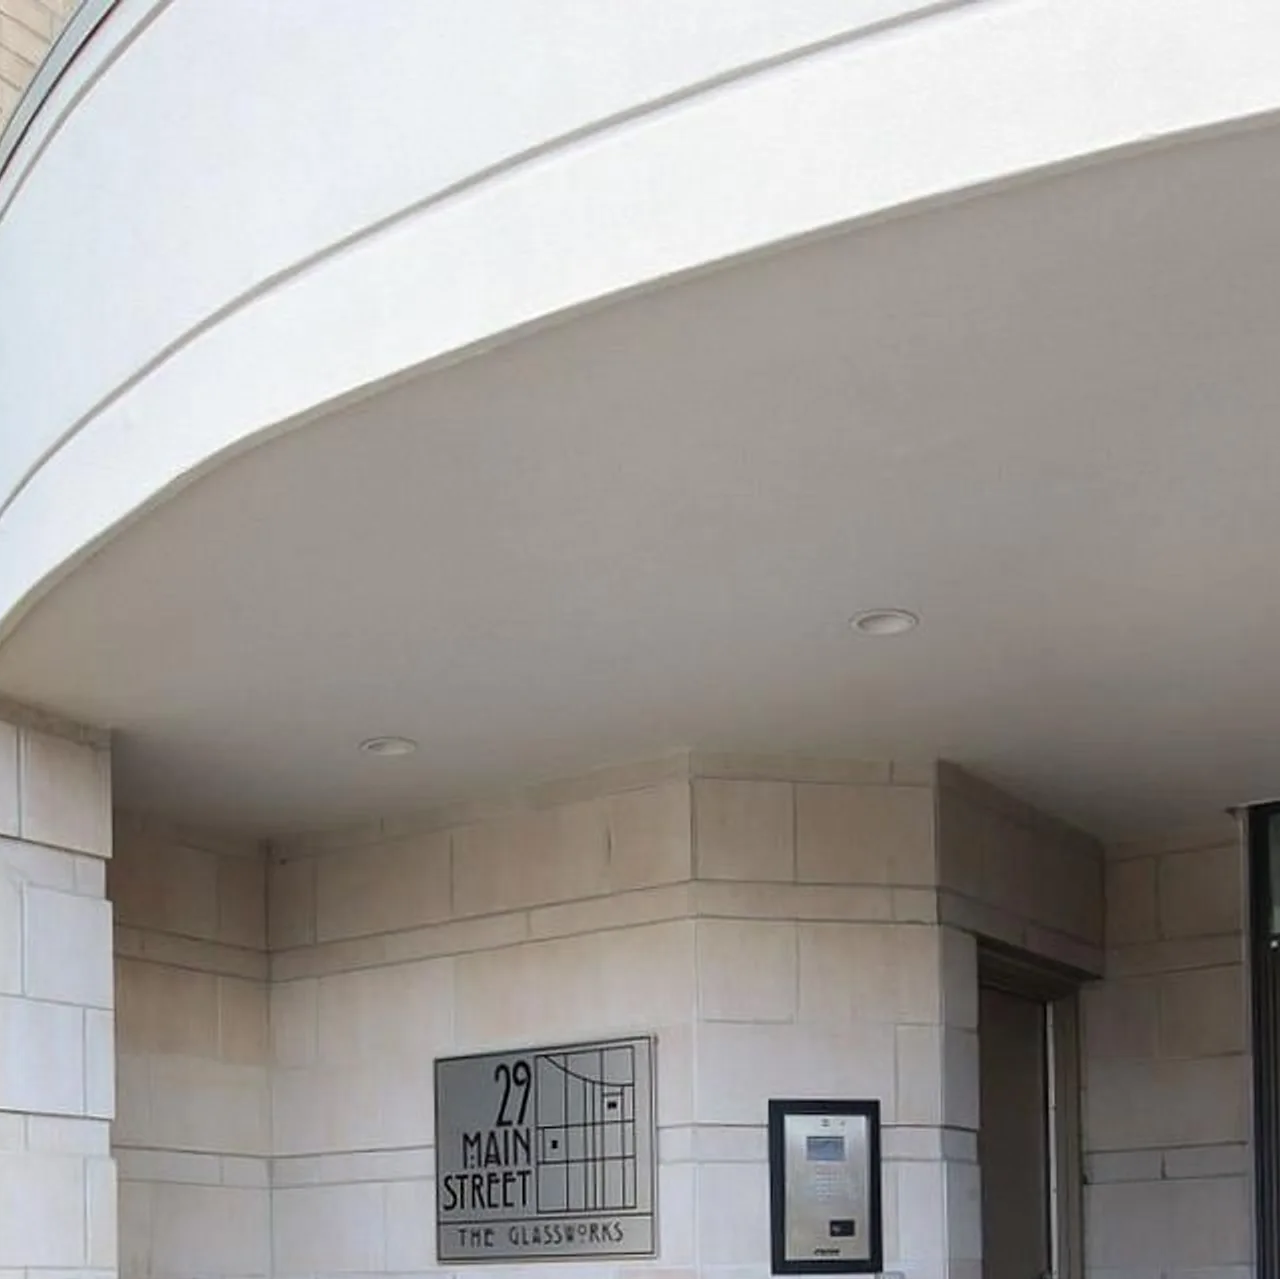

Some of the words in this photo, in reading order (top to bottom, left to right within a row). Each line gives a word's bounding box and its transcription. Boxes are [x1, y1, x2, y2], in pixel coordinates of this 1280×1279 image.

[494, 1061, 532, 1127] 29
[462, 1127, 531, 1170] MAIN
[443, 1170, 532, 1210] STREET
[457, 1228, 495, 1247] THE
[508, 1221, 624, 1246] GLASSWORKS
